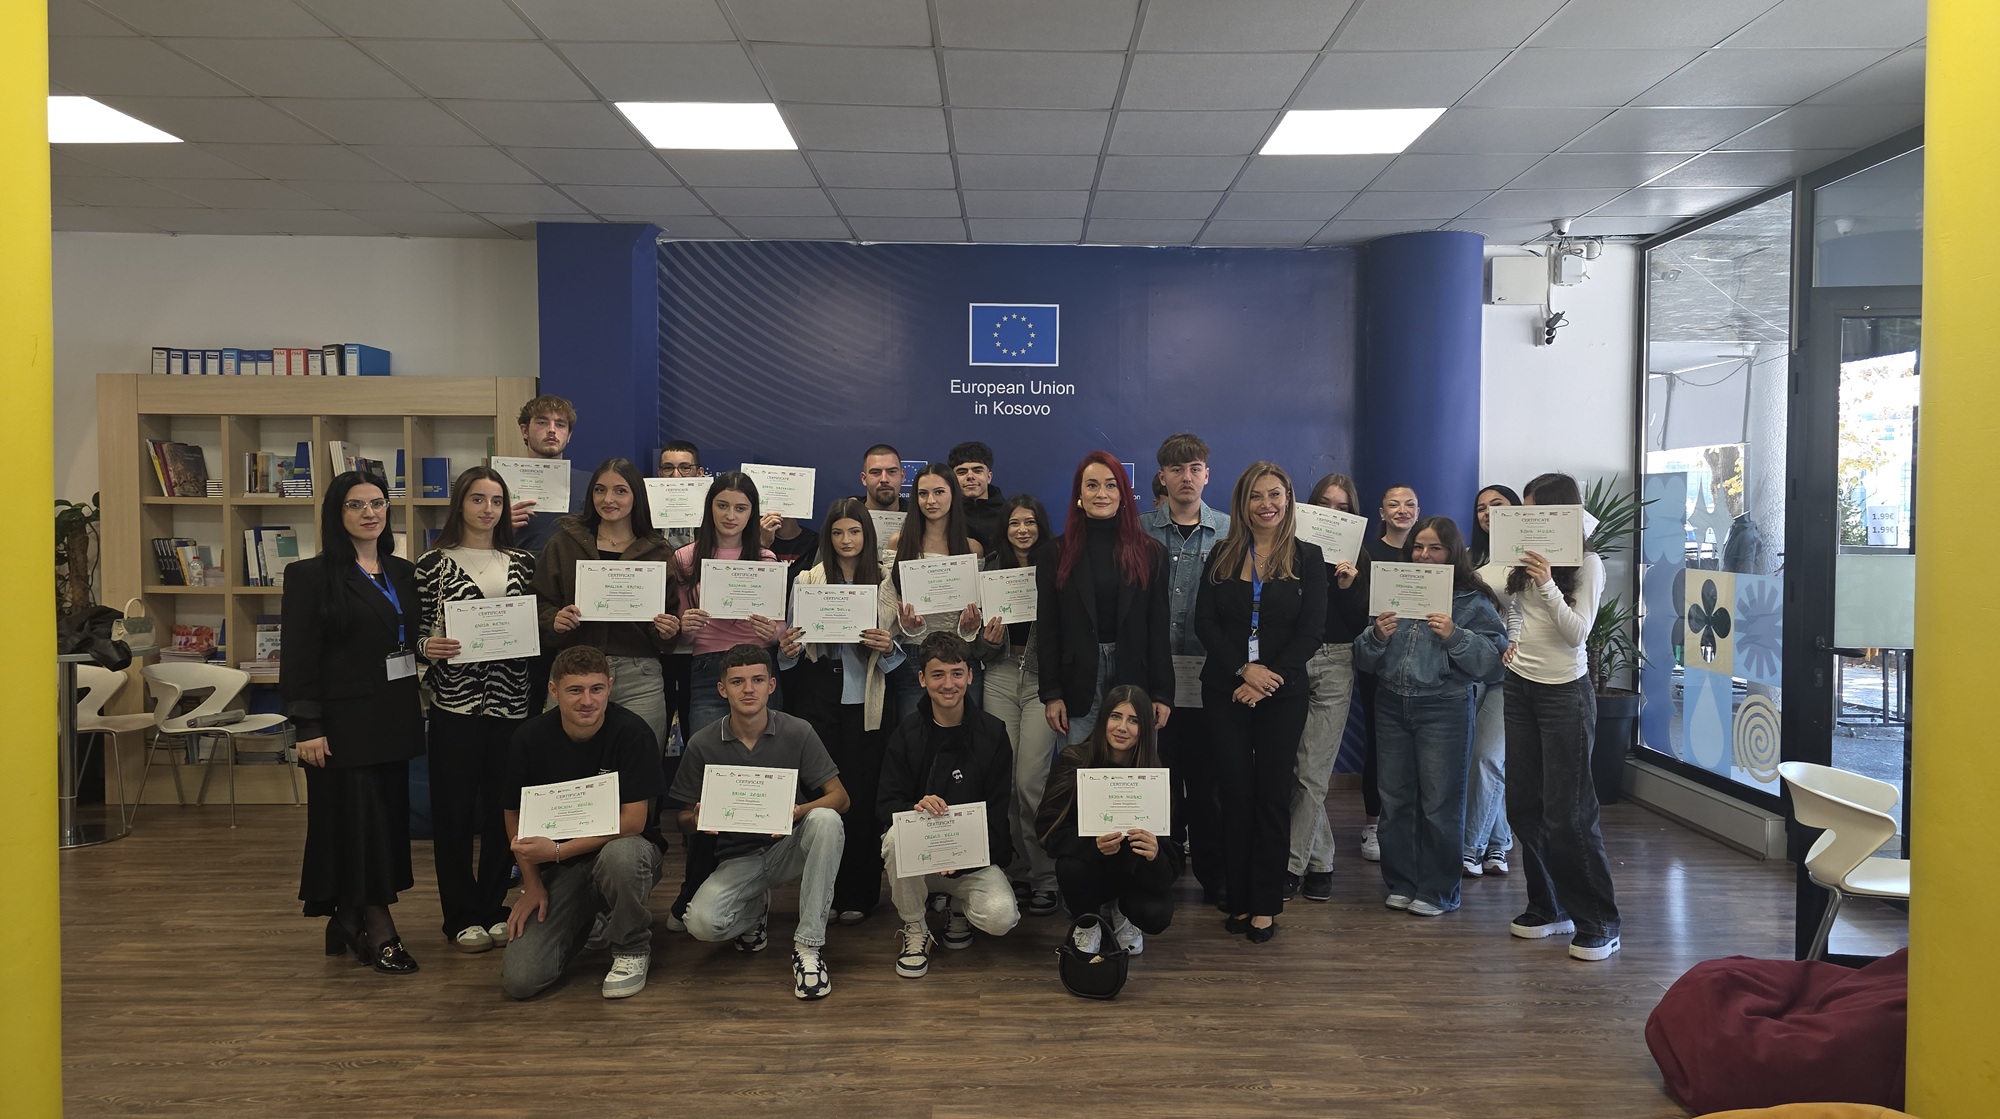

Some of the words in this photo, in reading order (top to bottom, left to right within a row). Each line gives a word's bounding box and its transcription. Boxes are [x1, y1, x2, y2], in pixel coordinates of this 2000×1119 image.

[950, 379, 1025, 397] European
[1030, 380, 1075, 395] Union
[974, 401, 988, 415] in
[993, 400, 1051, 416] Kosovo
[555, 791, 586, 800] CERTIFICATE
